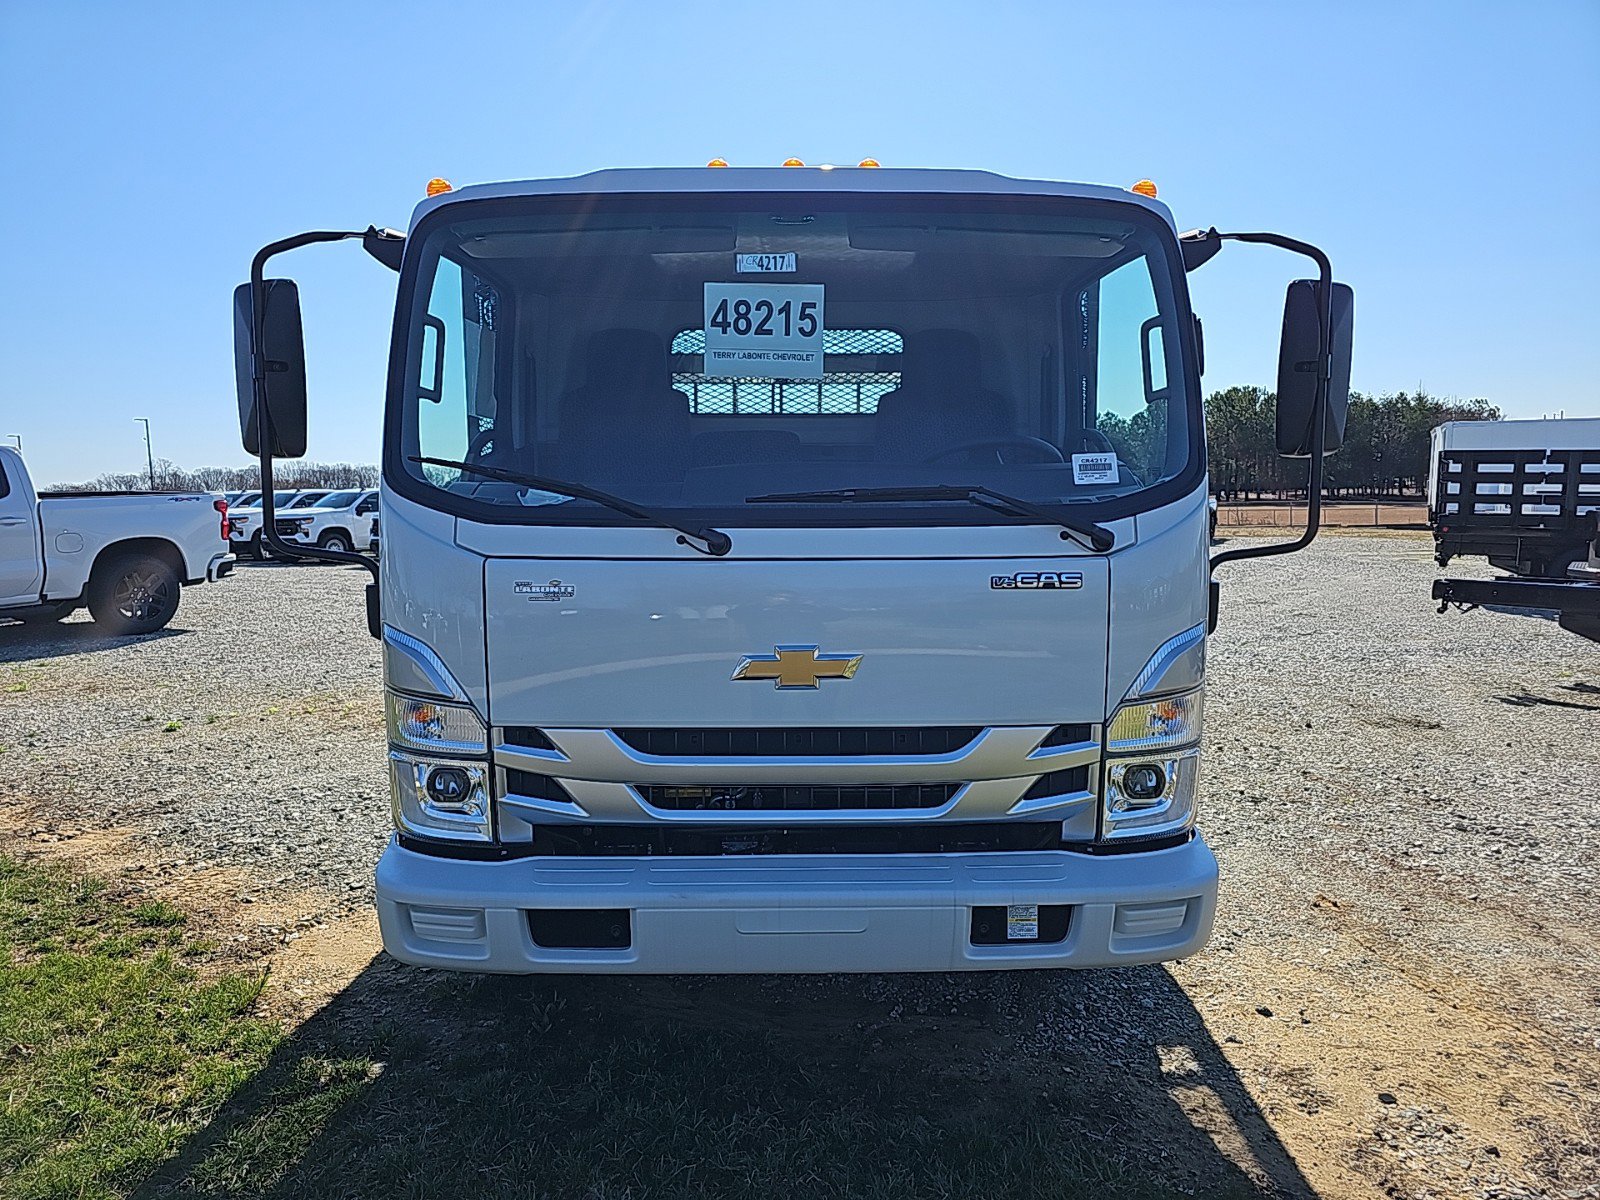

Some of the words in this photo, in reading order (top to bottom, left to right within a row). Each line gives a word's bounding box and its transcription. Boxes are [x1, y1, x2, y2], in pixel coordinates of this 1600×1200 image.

[710, 299, 817, 337] 48215
[713, 351, 736, 359] TERRY
[738, 352, 771, 360] LABONTE
[772, 353, 814, 361] CHEVROLET
[1016, 573, 1082, 588] GAS
